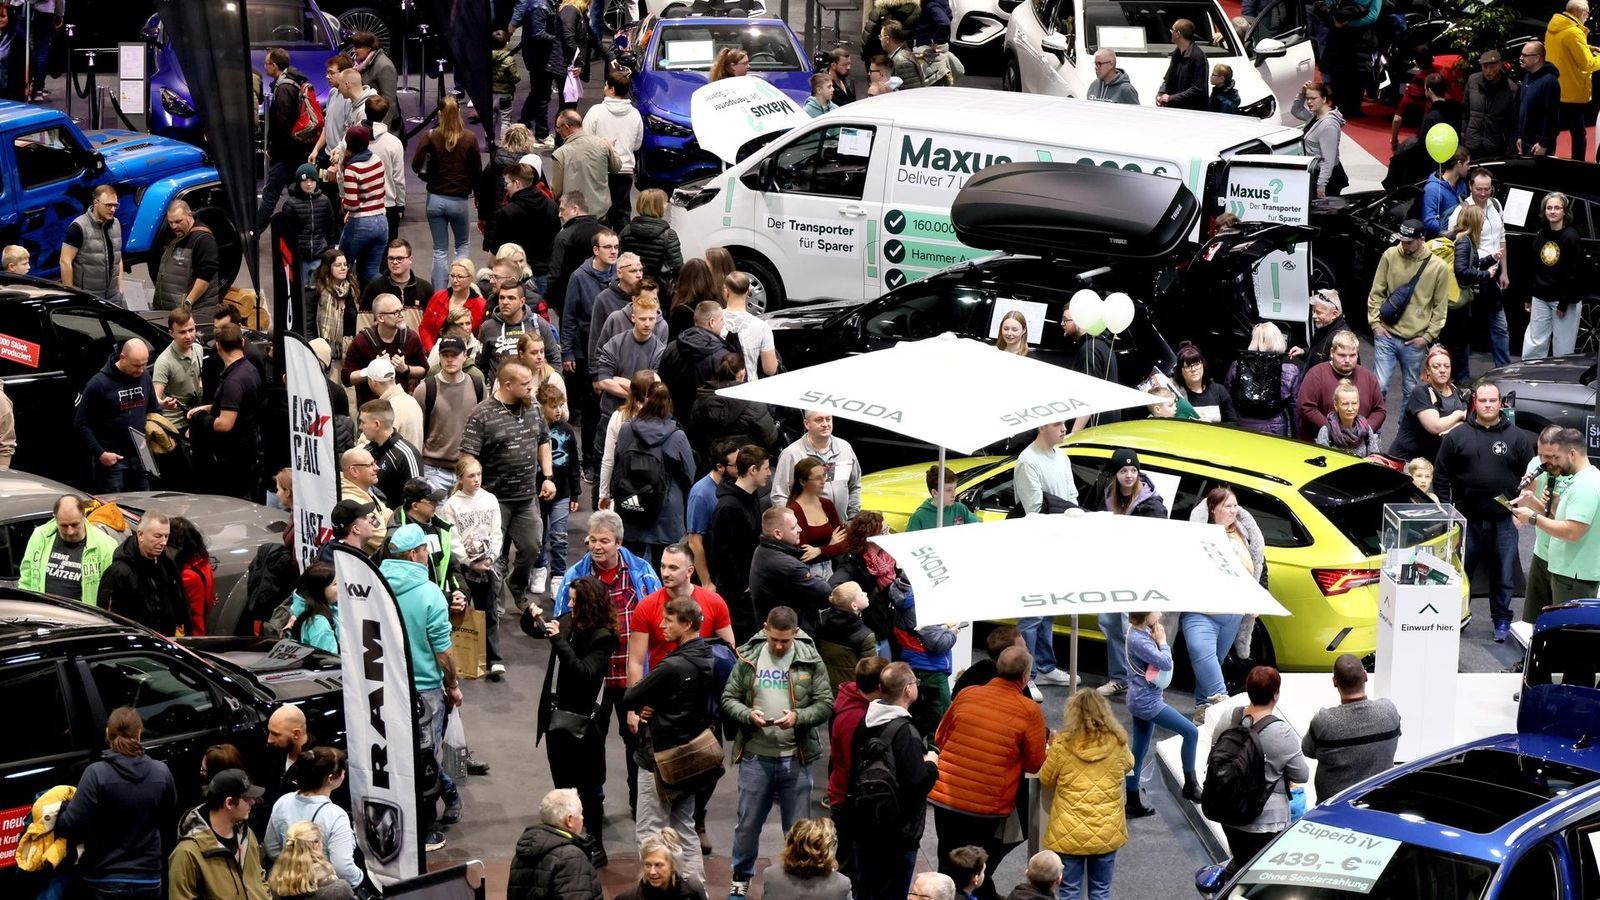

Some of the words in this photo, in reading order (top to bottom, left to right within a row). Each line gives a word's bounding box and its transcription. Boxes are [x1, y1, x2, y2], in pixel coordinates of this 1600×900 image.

[897, 168, 943, 187] Deliver
[947, 175, 956, 188] 7
[1230, 184, 1271, 200] Maxus
[1249, 202, 1261, 210] Der
[1262, 203, 1302, 213] Transporter
[767, 217, 787, 230] Der
[788, 219, 855, 236] Transporter
[1279, 214, 1302, 223] Sparer
[799, 236, 815, 249] für
[817, 238, 855, 253] Sparer
[911, 249, 957, 264] Hammer
[1401, 623, 1435, 631] Einwurf
[1436, 623, 1455, 631] hier.
[756, 670, 789, 680] JACK
[757, 679, 789, 690] JONE
[362, 619, 390, 790] RAM
[3, 833, 21, 845] Kraf
[1298, 822, 1357, 846] Superb
[1358, 836, 1382, 851] iV
[1268, 852, 1335, 871] 439,-
[1341, 856, 1363, 872] €
[1258, 871, 1287, 881] Ohne
[1288, 872, 1370, 892] Sonderzahlung
